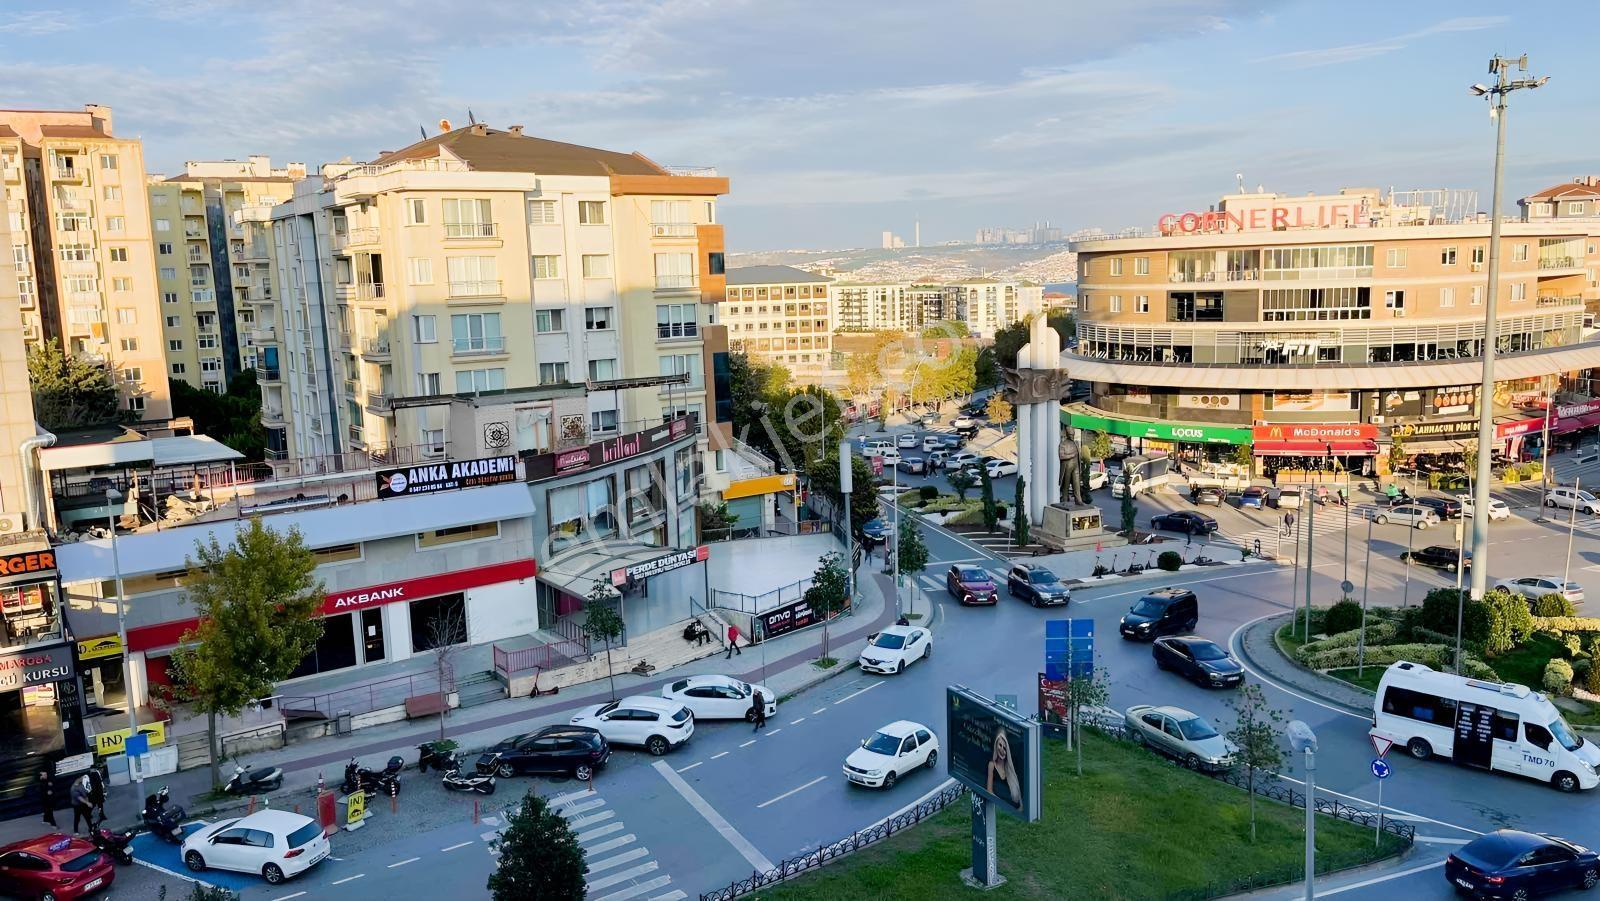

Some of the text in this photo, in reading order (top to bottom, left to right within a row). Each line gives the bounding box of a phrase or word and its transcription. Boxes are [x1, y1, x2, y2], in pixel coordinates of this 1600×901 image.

[1171, 427, 1204, 438] LOCUS
[1293, 427, 1361, 437] McDonald's
[408, 464, 448, 485] ANKA
[626, 560, 658, 577] PERDE
[658, 549, 697, 567] DÜNYASI
[334, 587, 405, 608] AKBANK
[23, 665, 69, 683] KURSU
[101, 734, 123, 748] HND
[1523, 754, 1555, 767] TMD 70
